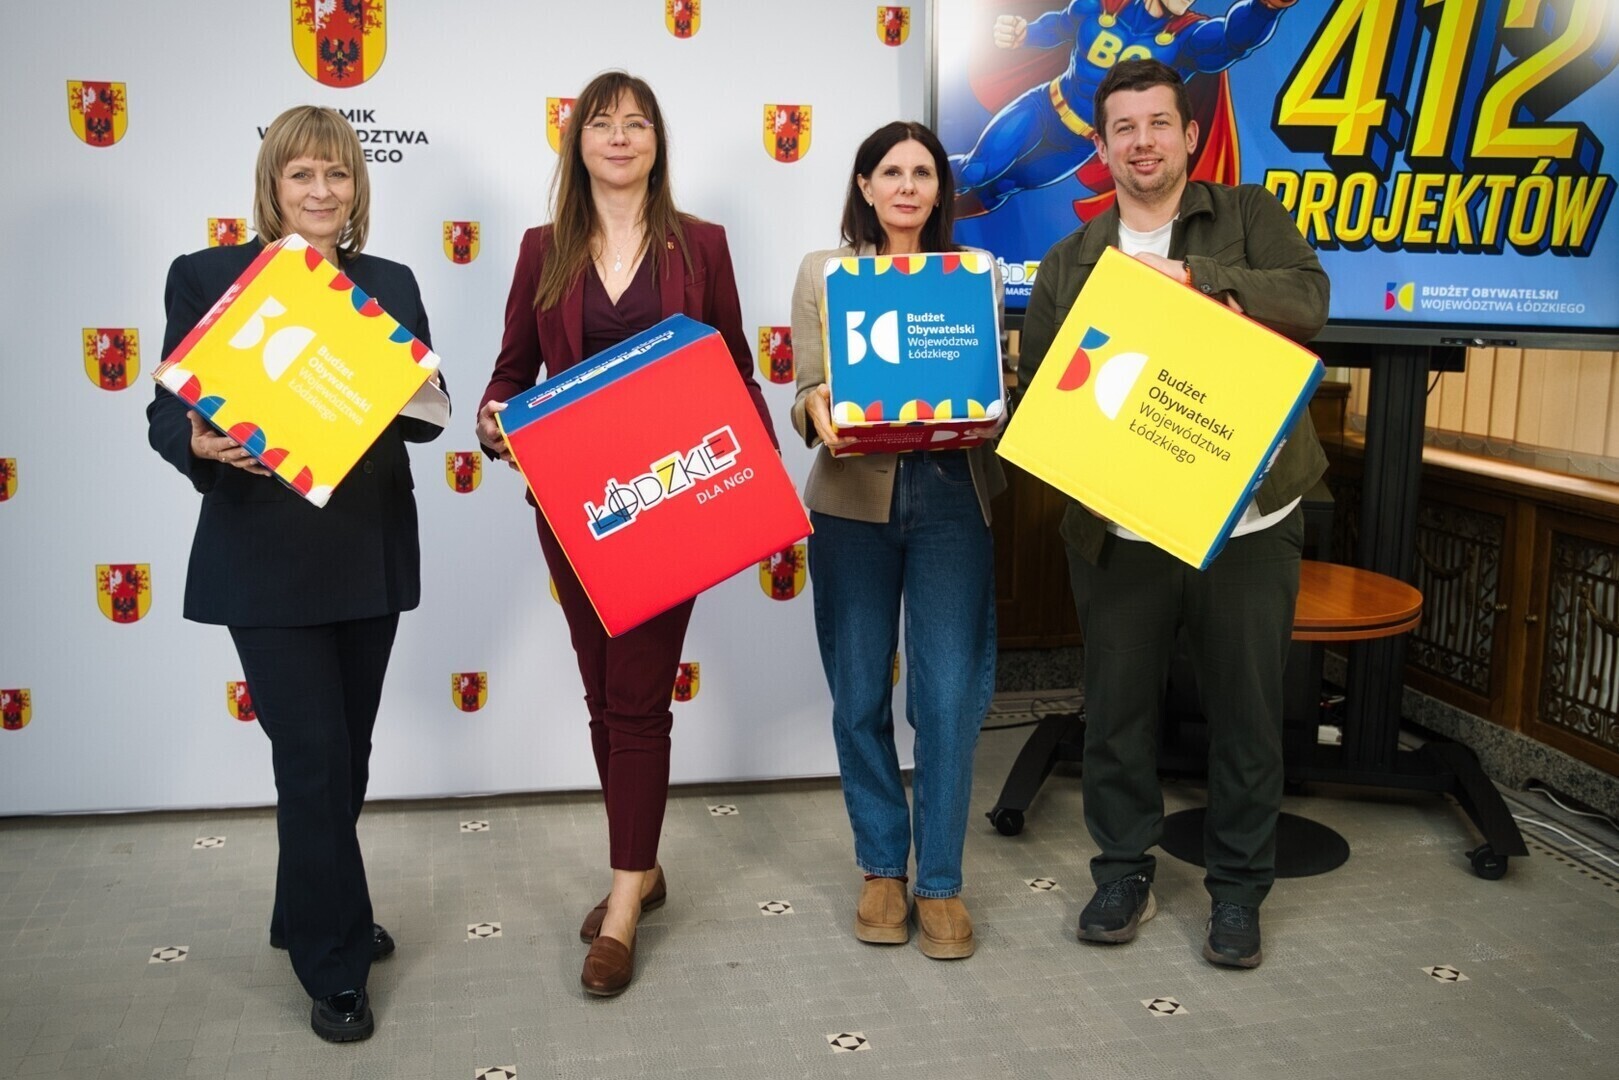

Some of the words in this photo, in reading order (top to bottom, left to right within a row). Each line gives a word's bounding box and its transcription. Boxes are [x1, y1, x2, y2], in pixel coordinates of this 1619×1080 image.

[1277, 0, 1608, 159] 412
[340, 109, 376, 123] MIK
[1265, 159, 1608, 247] PROJEKTÓW
[1421, 299, 1514, 312] WOJEWÓDZTWA
[1516, 301, 1586, 314] ŁÓDZKIEGO
[1422, 285, 1468, 297] BUDŻET
[1471, 288, 1559, 300] OBYWATELSKI
[907, 313, 945, 323] Budżet
[907, 325, 976, 337] Obywatelski
[908, 337, 979, 349] Województwa
[908, 349, 961, 361] Łódzkiego
[317, 345, 355, 380] Budżet
[299, 367, 364, 426] Województwa
[308, 356, 373, 413] Obywatelski
[1157, 369, 1208, 405] Budżet
[1148, 386, 1235, 441] Obywatelski
[1129, 418, 1196, 464] Łódzkiego
[1139, 402, 1231, 462] Województwa
[696, 487, 724, 505] DLA
[723, 467, 754, 490] NGO
